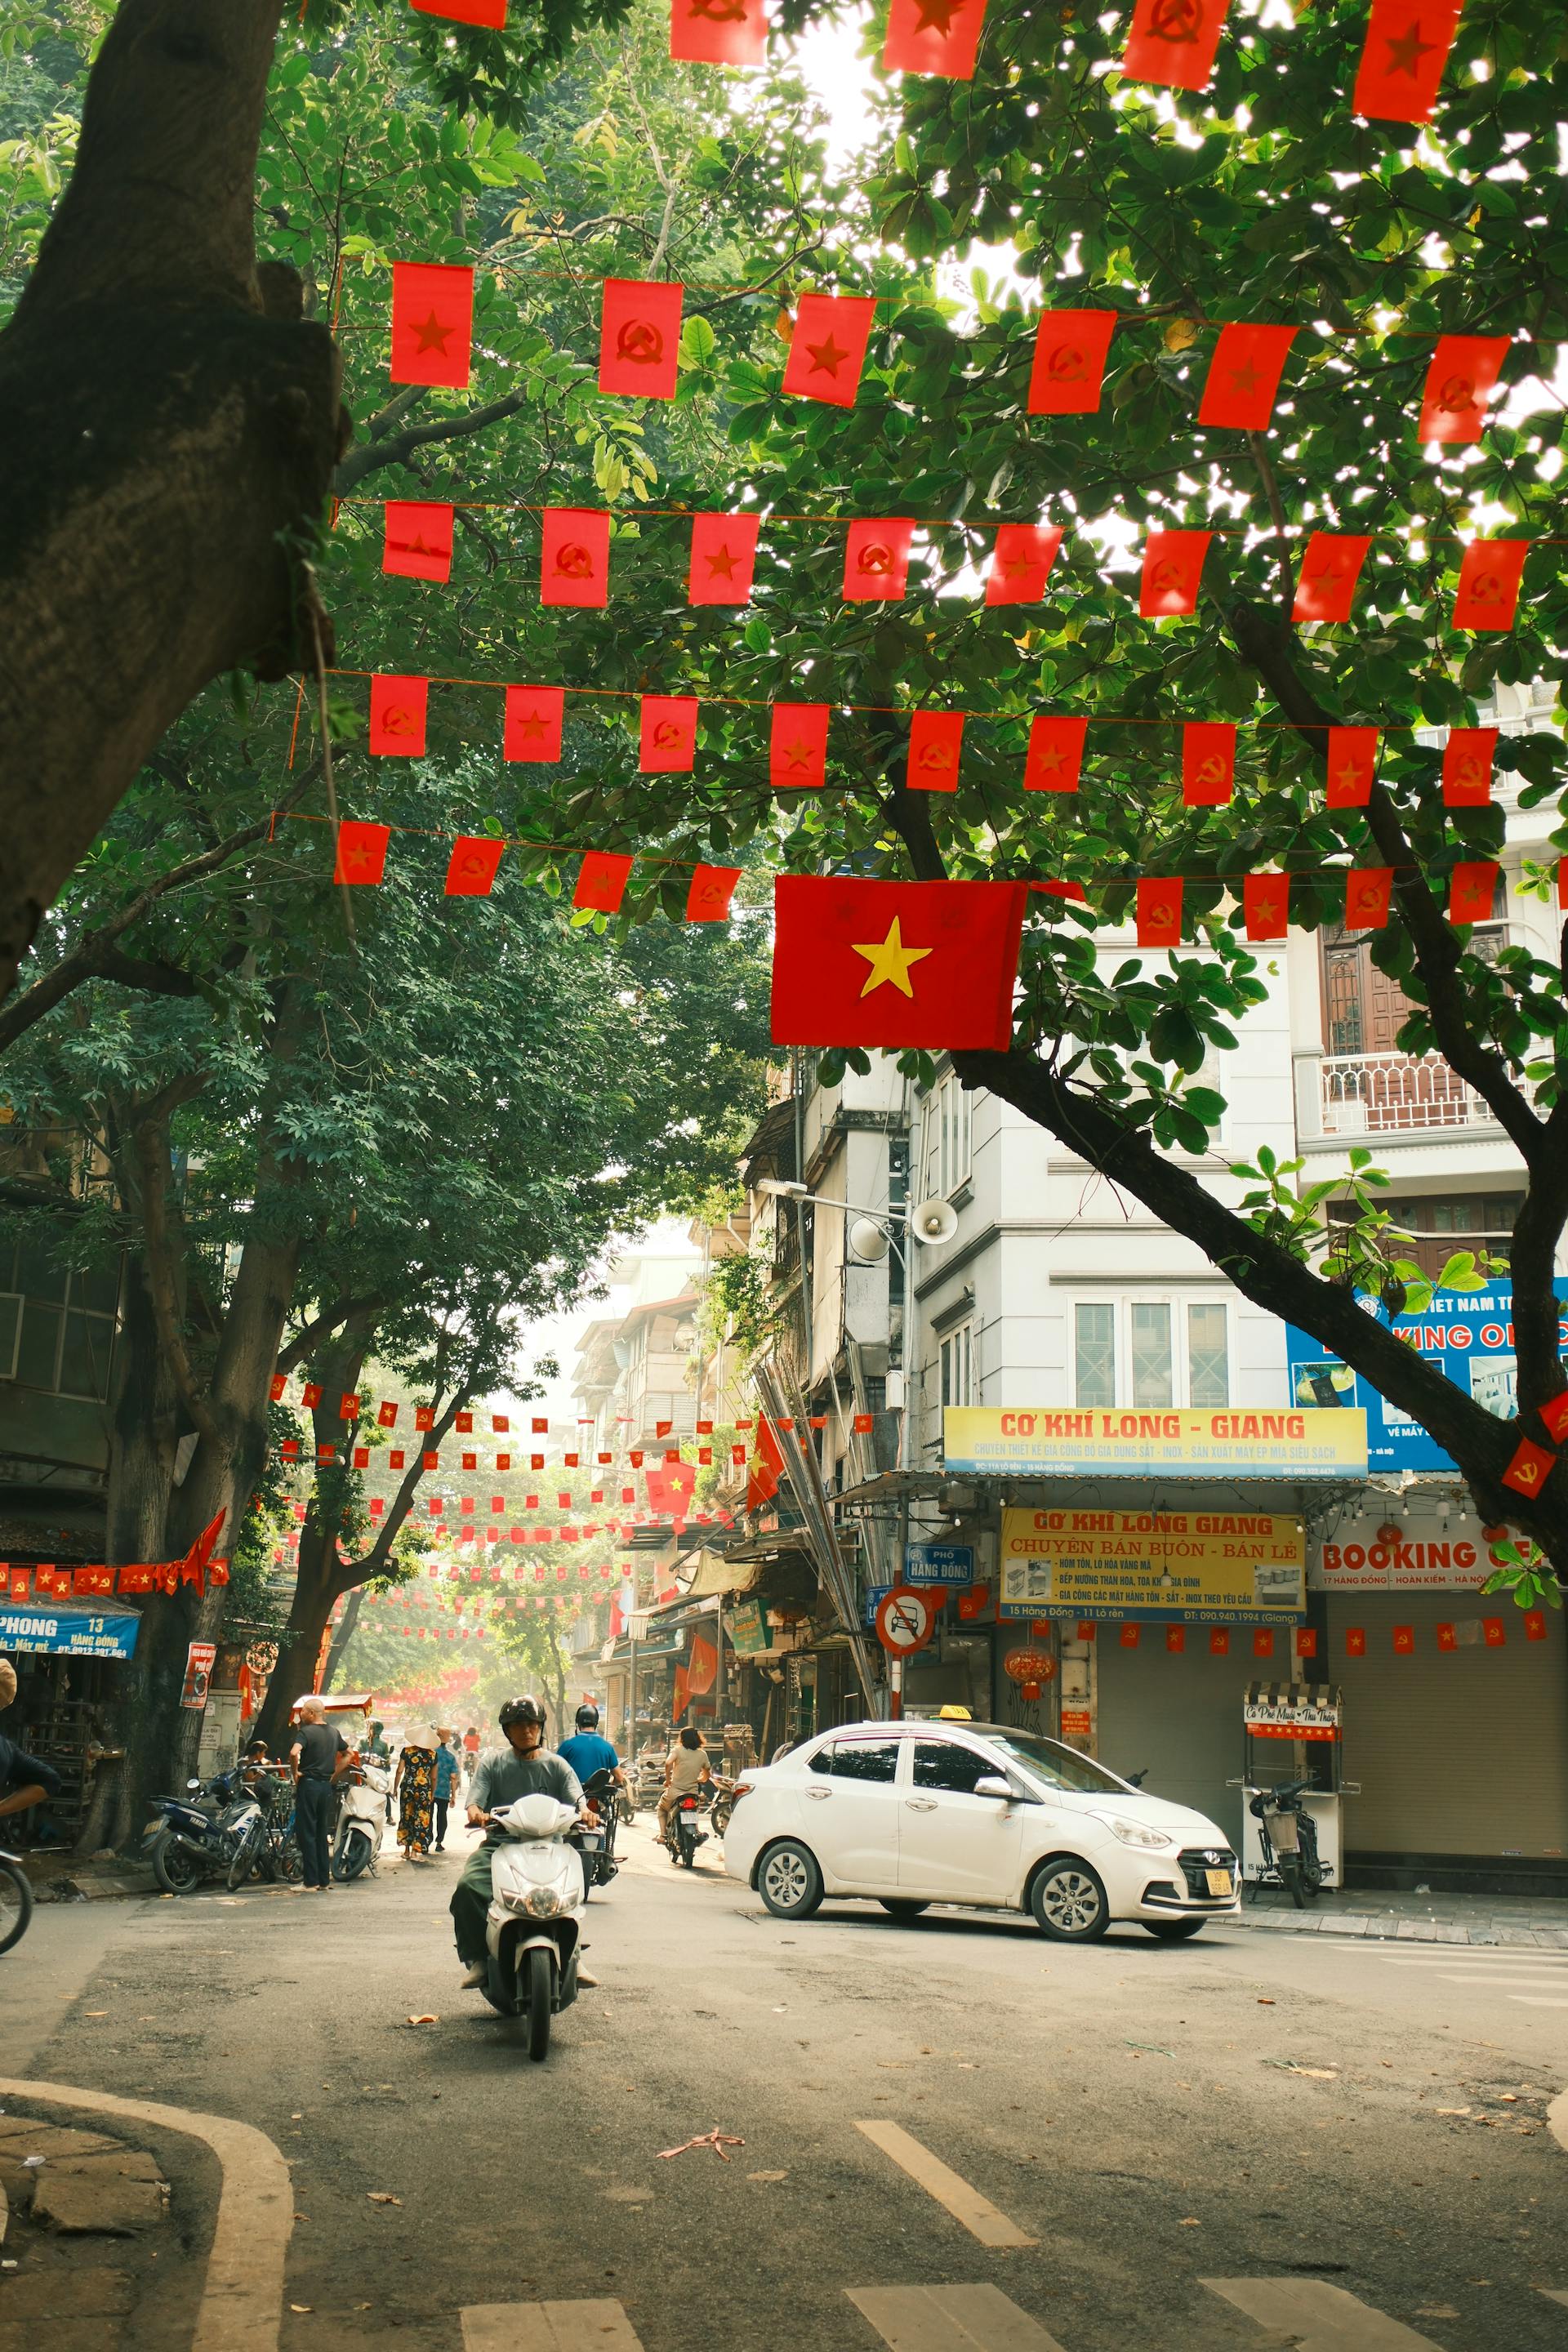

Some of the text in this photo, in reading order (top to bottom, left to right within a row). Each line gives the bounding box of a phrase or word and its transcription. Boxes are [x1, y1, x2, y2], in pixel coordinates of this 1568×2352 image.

[1458, 1297, 1494, 1312] NAM
[1001, 1414, 1037, 1437] CƠ
[1045, 1410, 1093, 1437] KHÍ
[1102, 1414, 1180, 1438] LONG
[1211, 1415, 1305, 1439] GIANG
[1401, 1426, 1423, 1437] MÁY
[974, 1442, 1006, 1455] CHUYÊN
[1045, 1444, 1058, 1457] GIA
[1060, 1442, 1082, 1457] CÔNG
[1098, 1445, 1111, 1458] GIA
[1163, 1446, 1183, 1459] INOX
[1034, 1511, 1272, 1535] CƠ KHÍ LONG GIANG
[933, 1549, 955, 1559] PHỐ
[1010, 1537, 1094, 1555] CHUYÊN
[1100, 1538, 1143, 1556] BÁN
[1148, 1539, 1205, 1557] BUÔN
[1223, 1541, 1265, 1558] BÁN
[1271, 1540, 1297, 1559] LẺ
[1323, 1542, 1477, 1570] BOOKING
[911, 1560, 938, 1576] HÀNG
[1100, 1575, 1118, 1586] THAN
[1334, 1575, 1359, 1584] HÀNG
[1396, 1575, 1422, 1584] HOÀN
[1424, 1574, 1446, 1584] KIẾM
[1454, 1575, 1468, 1584] HÀ
[1059, 1591, 1071, 1600] GIA
[1072, 1589, 1091, 1601] CÔNG
[1186, 1594, 1202, 1603] INOX
[1204, 1594, 1221, 1604] THEO
[1009, 1606, 1020, 1615] 15
[1022, 1606, 1046, 1617] Hàng
[1096, 1609, 1107, 1617] Lò
[1108, 1608, 1124, 1618] rèn
[1184, 1611, 1298, 1624] ĐT: 090.940.1994 (Giang)
[89, 1618, 105, 1633] 13
[71, 1633, 94, 1646] HÀNG
